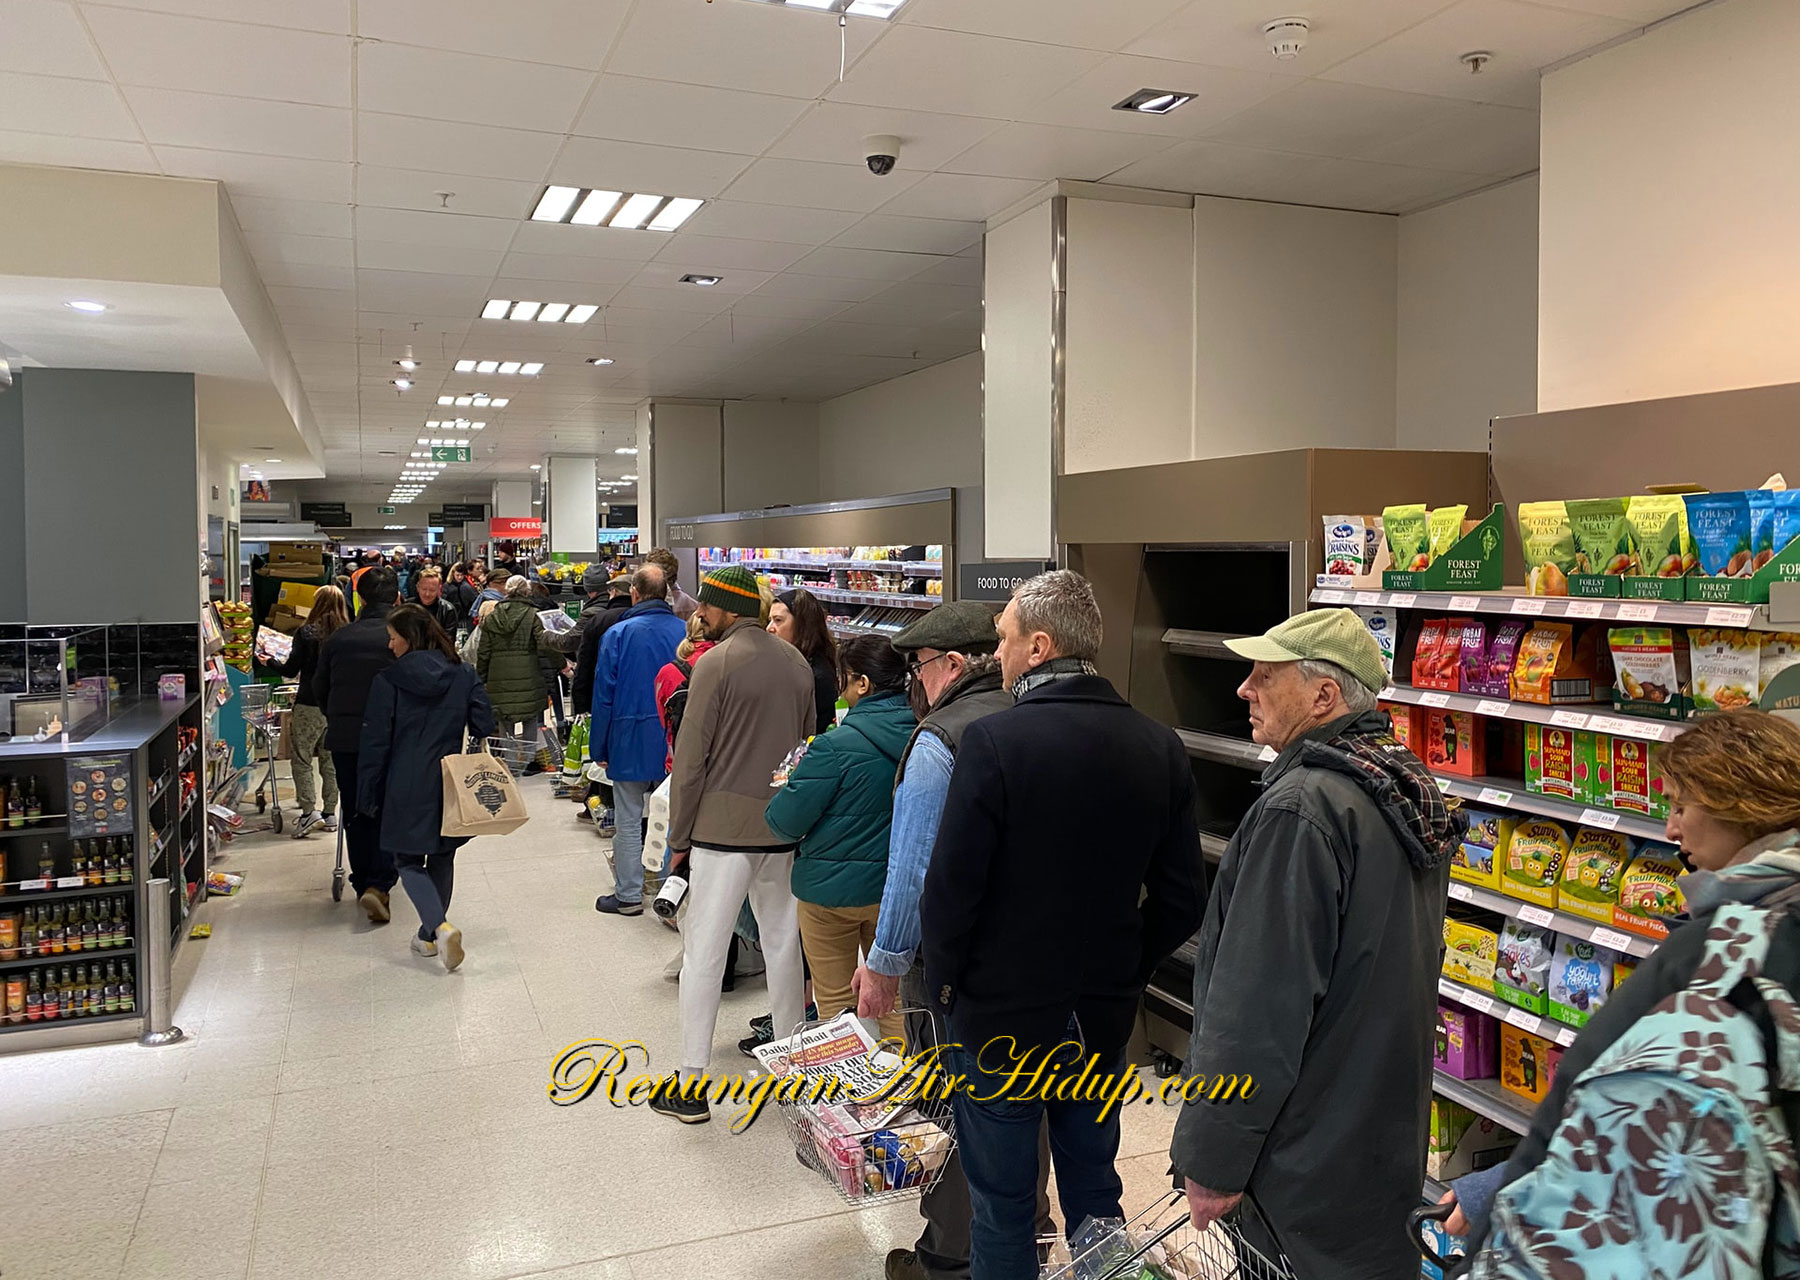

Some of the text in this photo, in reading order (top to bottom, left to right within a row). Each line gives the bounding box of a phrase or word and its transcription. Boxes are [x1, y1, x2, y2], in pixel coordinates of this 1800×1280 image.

[1580, 514, 1617, 522] FOREST
[1634, 512, 1668, 520] FOREST
[1695, 508, 1737, 519] FOREST
[509, 521, 541, 529] OFFERS
[1528, 517, 1566, 527] FOREST
[1582, 522, 1612, 530] FEAST
[1636, 520, 1665, 529] FEAST
[1698, 518, 1735, 528] FEAST
[670, 526, 681, 540] FOOD
[1530, 526, 1561, 535] FEAST
[1530, 547, 1557, 556] PEAR
[1447, 560, 1482, 569] FOREST
[1450, 569, 1479, 579] FEAST
[978, 577, 998, 589] FOOD
[999, 577, 1010, 589] TO
[1634, 582, 1664, 590] FOREST
[1698, 583, 1733, 591] FOREST
[1581, 586, 1605, 594] FEAST
[1637, 589, 1663, 598] FEAST
[1701, 591, 1730, 600] FEAST
[1462, 627, 1482, 638] URBAN
[1533, 631, 1559, 639] URBAN
[1461, 638, 1481, 648] FRUIT
[1530, 636, 1555, 650] FRUIT
[1444, 727, 1456, 735] BEAR
[1549, 753, 1564, 762] SOUR
[1545, 759, 1570, 772] RAISIN
[1621, 766, 1638, 775] SOUR
[1549, 769, 1566, 779] SNACKS
[1616, 771, 1645, 786] RAISIN
[1620, 783, 1640, 793] SNACKS
[1526, 824, 1560, 843] Sunny
[1580, 830, 1622, 851] Sunny
[1504, 881, 1516, 890] REAL
[1516, 885, 1532, 894] FRUIT
[1615, 911, 1629, 922] REAL
[1629, 916, 1648, 928] FRUIT
[1567, 964, 1599, 986] yogurt
[759, 1044, 790, 1058] Daily
[801, 1031, 828, 1047] Mail
[1522, 1051, 1536, 1062] BEAR
